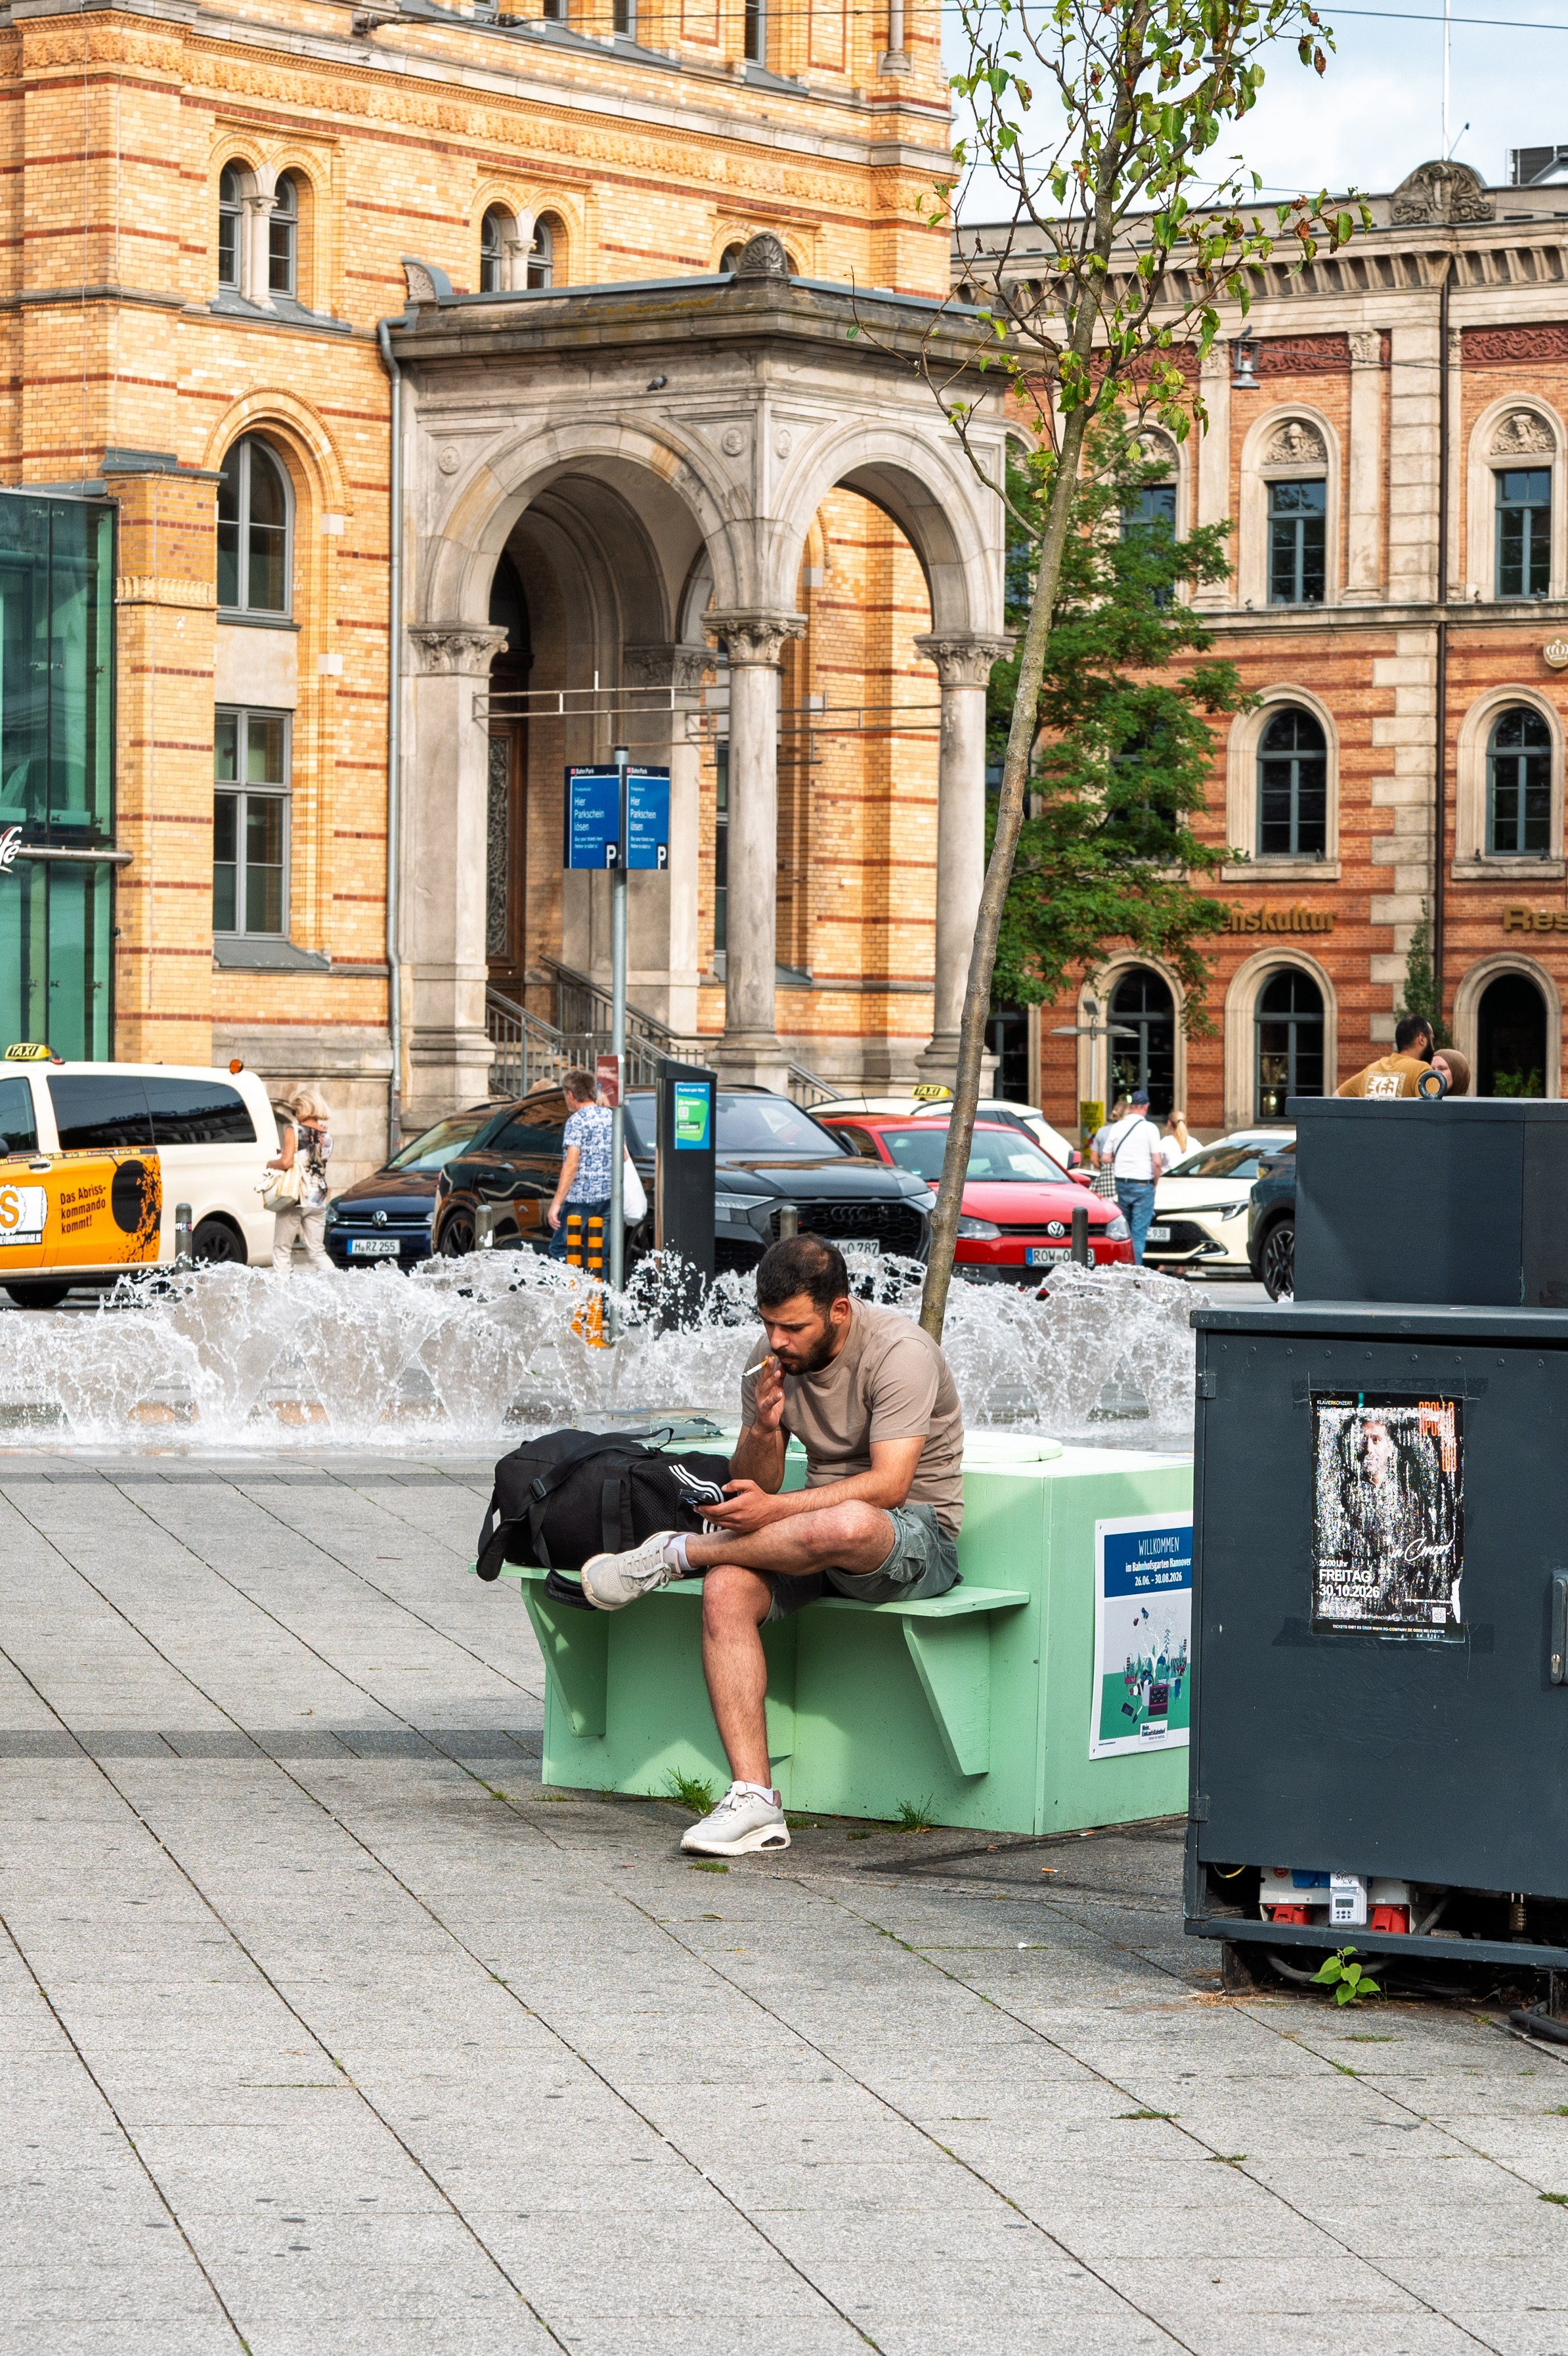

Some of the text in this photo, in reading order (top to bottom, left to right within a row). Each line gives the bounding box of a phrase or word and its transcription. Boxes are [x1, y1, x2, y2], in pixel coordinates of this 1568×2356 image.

[575, 797, 586, 806] Hier
[630, 796, 640, 806] Hier
[575, 809, 605, 818] Parkschein
[630, 809, 657, 819] Parkschein
[575, 822, 589, 831] lösen
[630, 821, 643, 831] lösen
[0, 825, 23, 866] fé
[606, 844, 617, 868] P
[658, 846, 666, 869] P
[1503, 905, 1568, 930] Res
[11, 1046, 37, 1057] TAXI
[917, 1087, 939, 1096] TAXI
[60, 1184, 106, 1205] Das Abriss-
[61, 1199, 106, 1220] kommando
[61, 1215, 93, 1234] kommt!
[1152, 1229, 1167, 1238] 938
[380, 1242, 395, 1252] 255
[858, 1242, 879, 1254] 787
[1034, 1250, 1055, 1261] ROW
[1139, 1537, 1179, 1556] WILLKOMMEN
[1125, 1558, 1191, 1572] im Bahnhofsgarten Hannover
[1135, 1575, 1150, 1586] 26.06.
[1155, 1572, 1183, 1584] 30.08.2026
[1319, 1569, 1371, 1582] FREITAG
[1318, 1584, 1380, 1598] 30.10.2026
